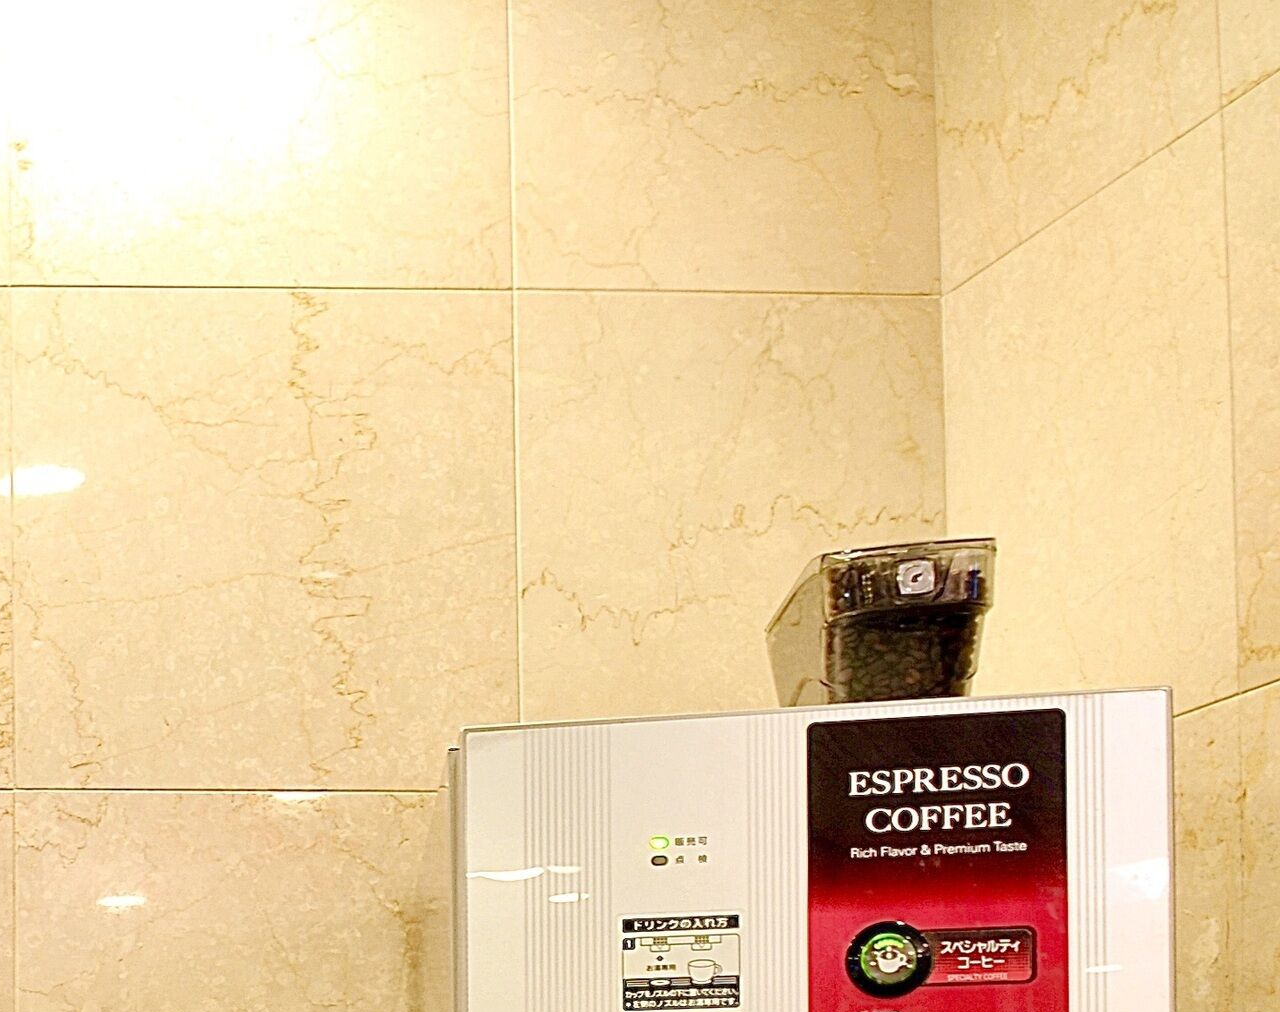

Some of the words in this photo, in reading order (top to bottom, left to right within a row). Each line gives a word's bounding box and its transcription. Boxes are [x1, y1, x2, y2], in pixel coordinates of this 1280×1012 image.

[848, 762, 1030, 796] ESPRESSO
[865, 801, 1012, 833] COFFEE
[850, 846, 878, 859] Rich
[880, 844, 917, 858] Flavor
[920, 844, 931, 857] &
[934, 841, 991, 855] Premium
[993, 839, 1028, 853] Taste
[633, 917, 729, 931] ドリンクの入れ方
[626, 940, 633, 949] 1
[940, 939, 1021, 954] スペシャルティ
[957, 956, 1006, 969] コーヒー
